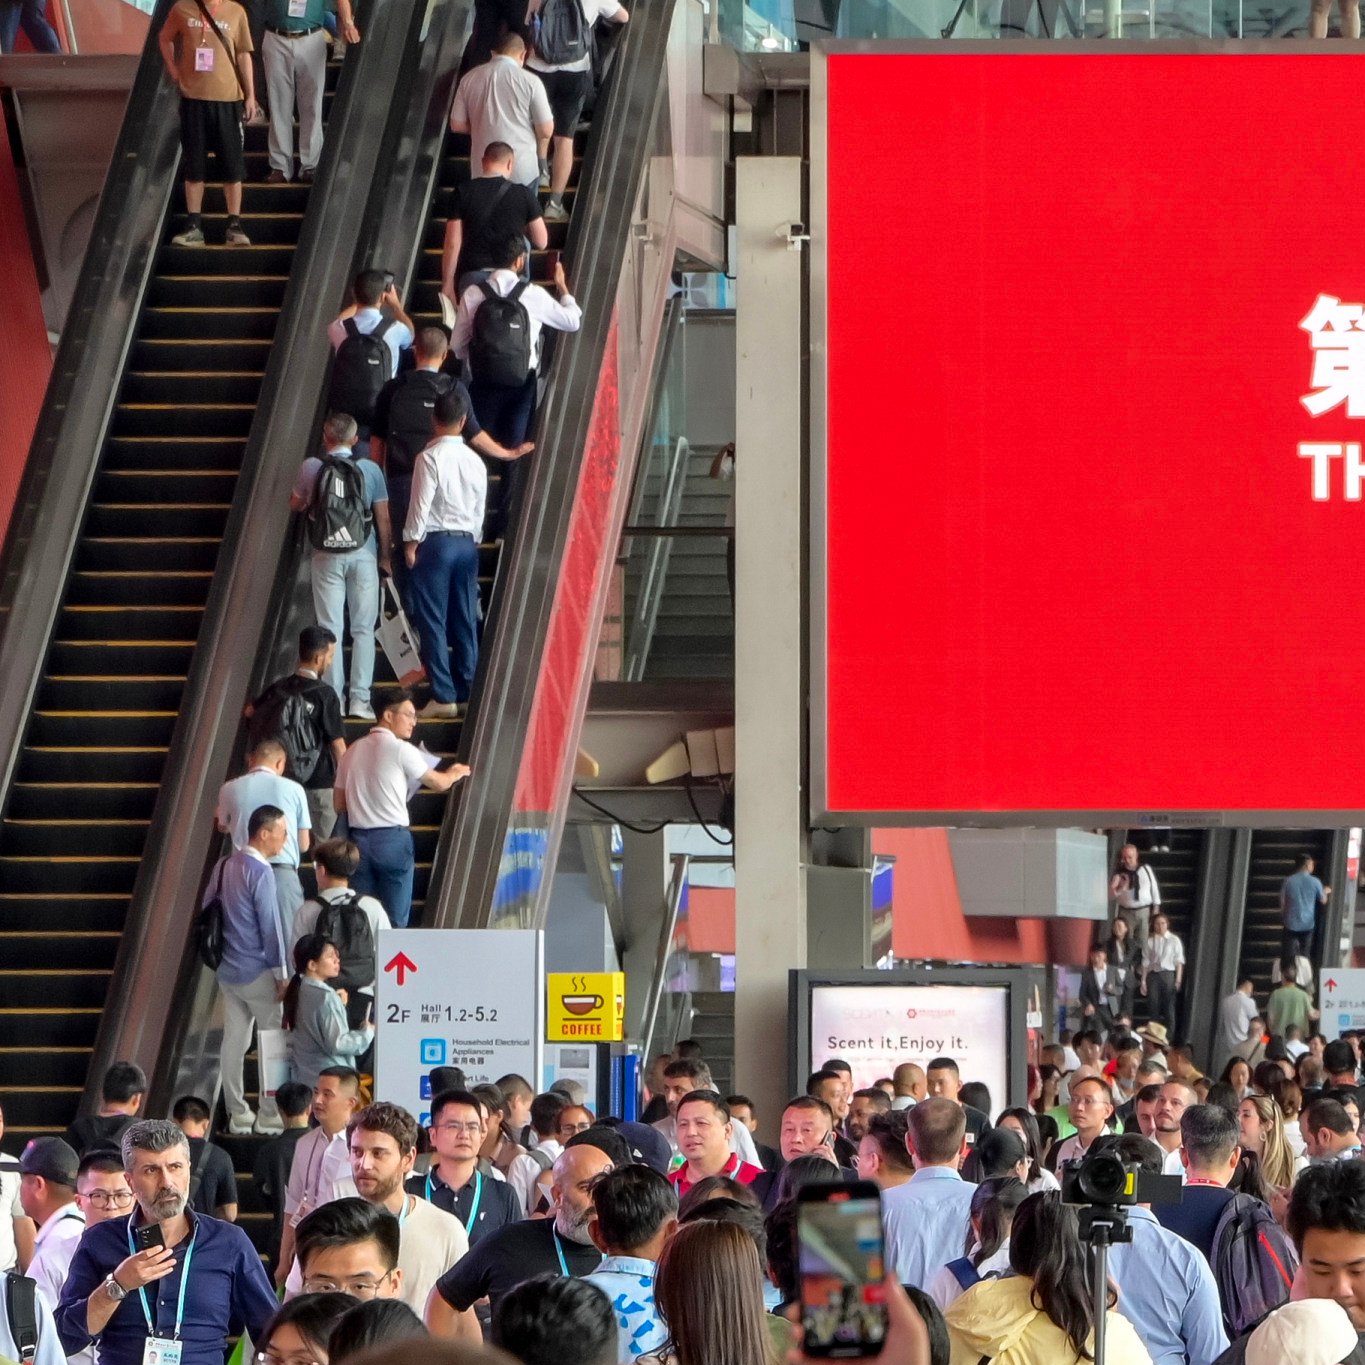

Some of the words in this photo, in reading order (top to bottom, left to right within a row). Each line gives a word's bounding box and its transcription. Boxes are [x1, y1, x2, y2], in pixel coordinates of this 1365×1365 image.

[323, 540, 357, 548] adidas
[387, 1003, 411, 1023] 2F
[421, 1003, 441, 1012] Hall
[445, 1006, 498, 1022] 1.2-5.2
[421, 1014, 441, 1023] 展厅
[562, 1024, 602, 1035] COFFEE
[452, 1038, 494, 1046] Household
[495, 1038, 530, 1046] Electrical
[828, 1036, 874, 1050] Scent
[951, 1036, 968, 1050] it.
[452, 1048, 494, 1056] Appliances
